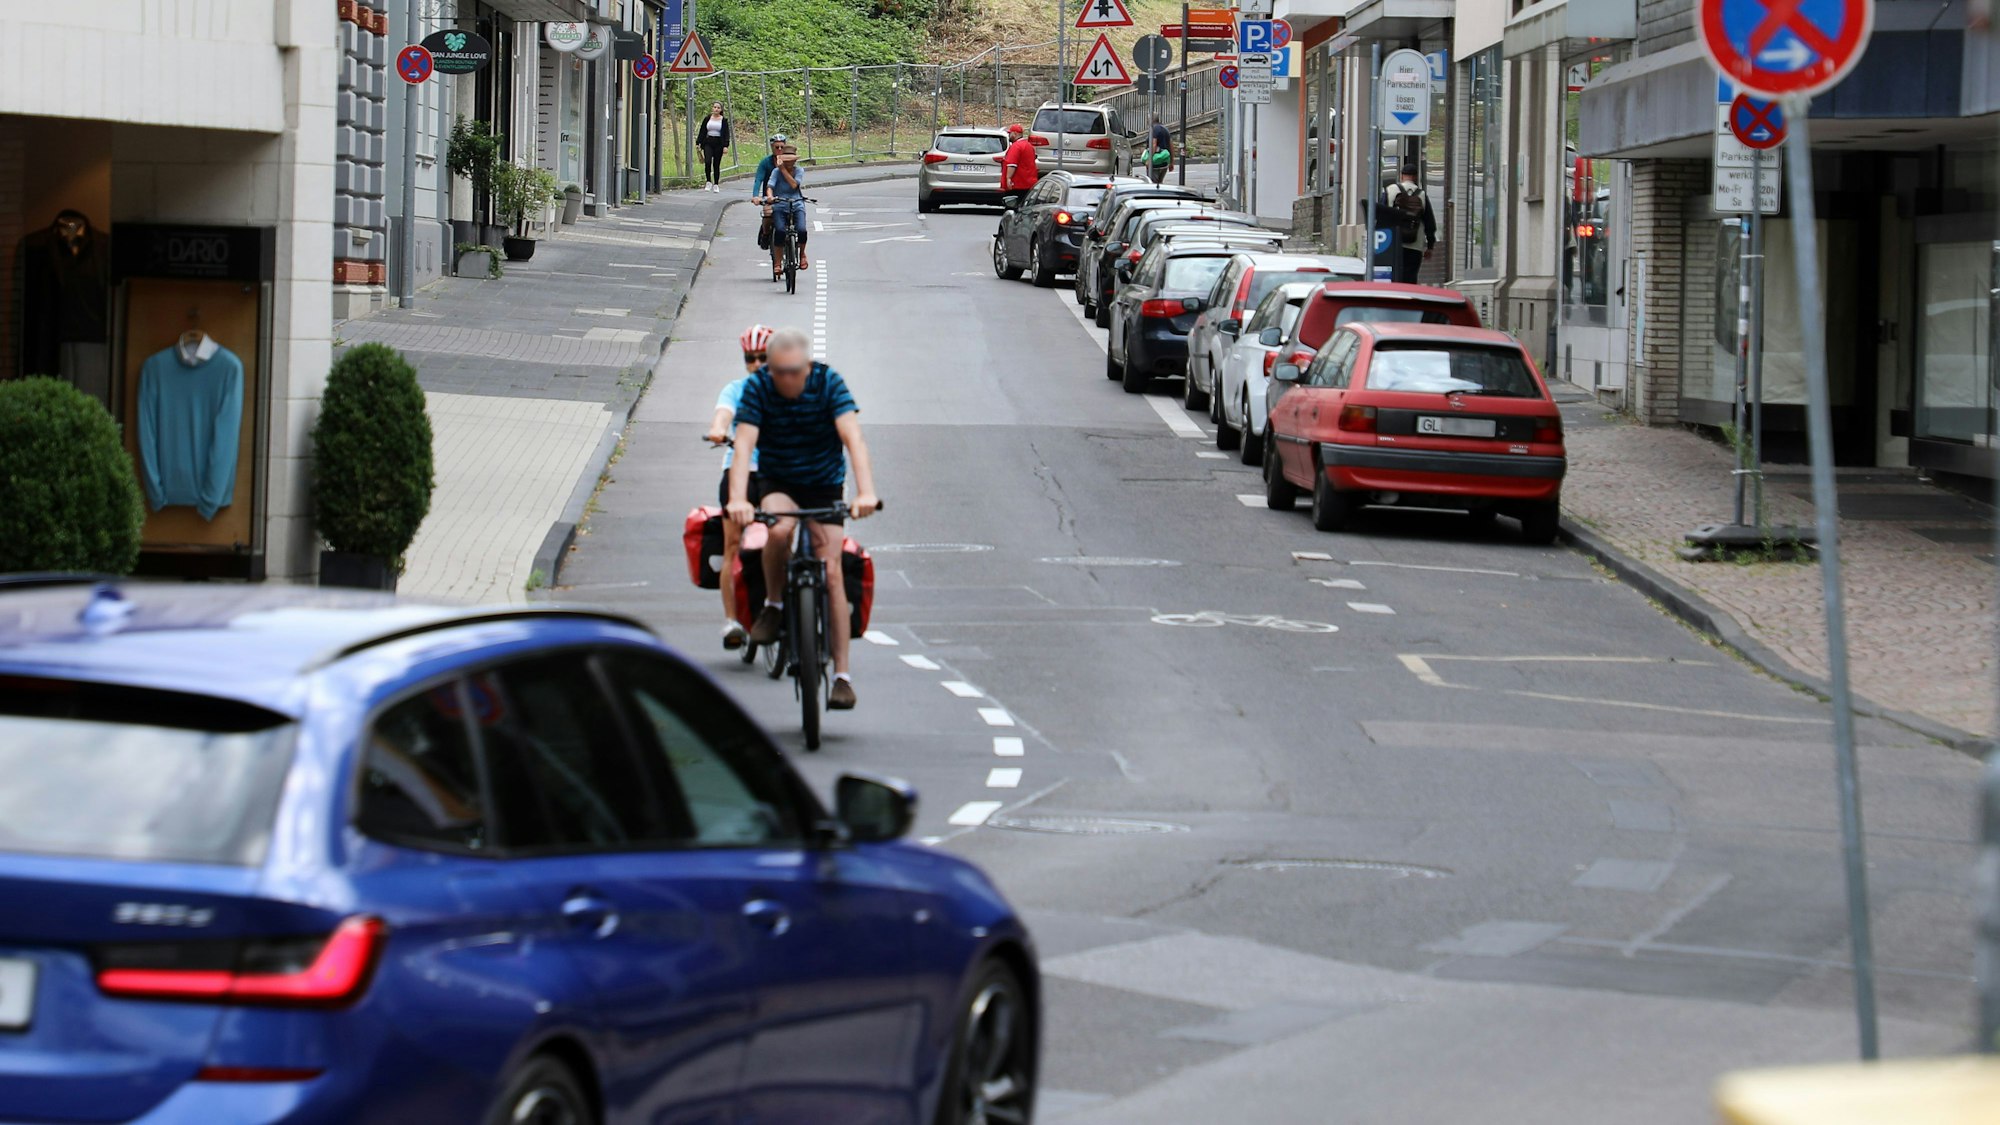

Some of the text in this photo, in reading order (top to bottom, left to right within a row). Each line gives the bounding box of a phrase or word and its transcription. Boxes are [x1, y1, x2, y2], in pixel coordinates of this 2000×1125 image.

[1247, 25, 1265, 49] P
[1399, 65, 1414, 74] Hier
[1387, 80, 1426, 89] Parkschein
[1721, 152, 1776, 162] Parkscein
[1718, 186, 1743, 194] Mo-Fr
[1732, 198, 1742, 207] Sa
[1375, 231, 1387, 250] P
[168, 237, 229, 263] DARIO
[1423, 418, 1440, 432] GL
